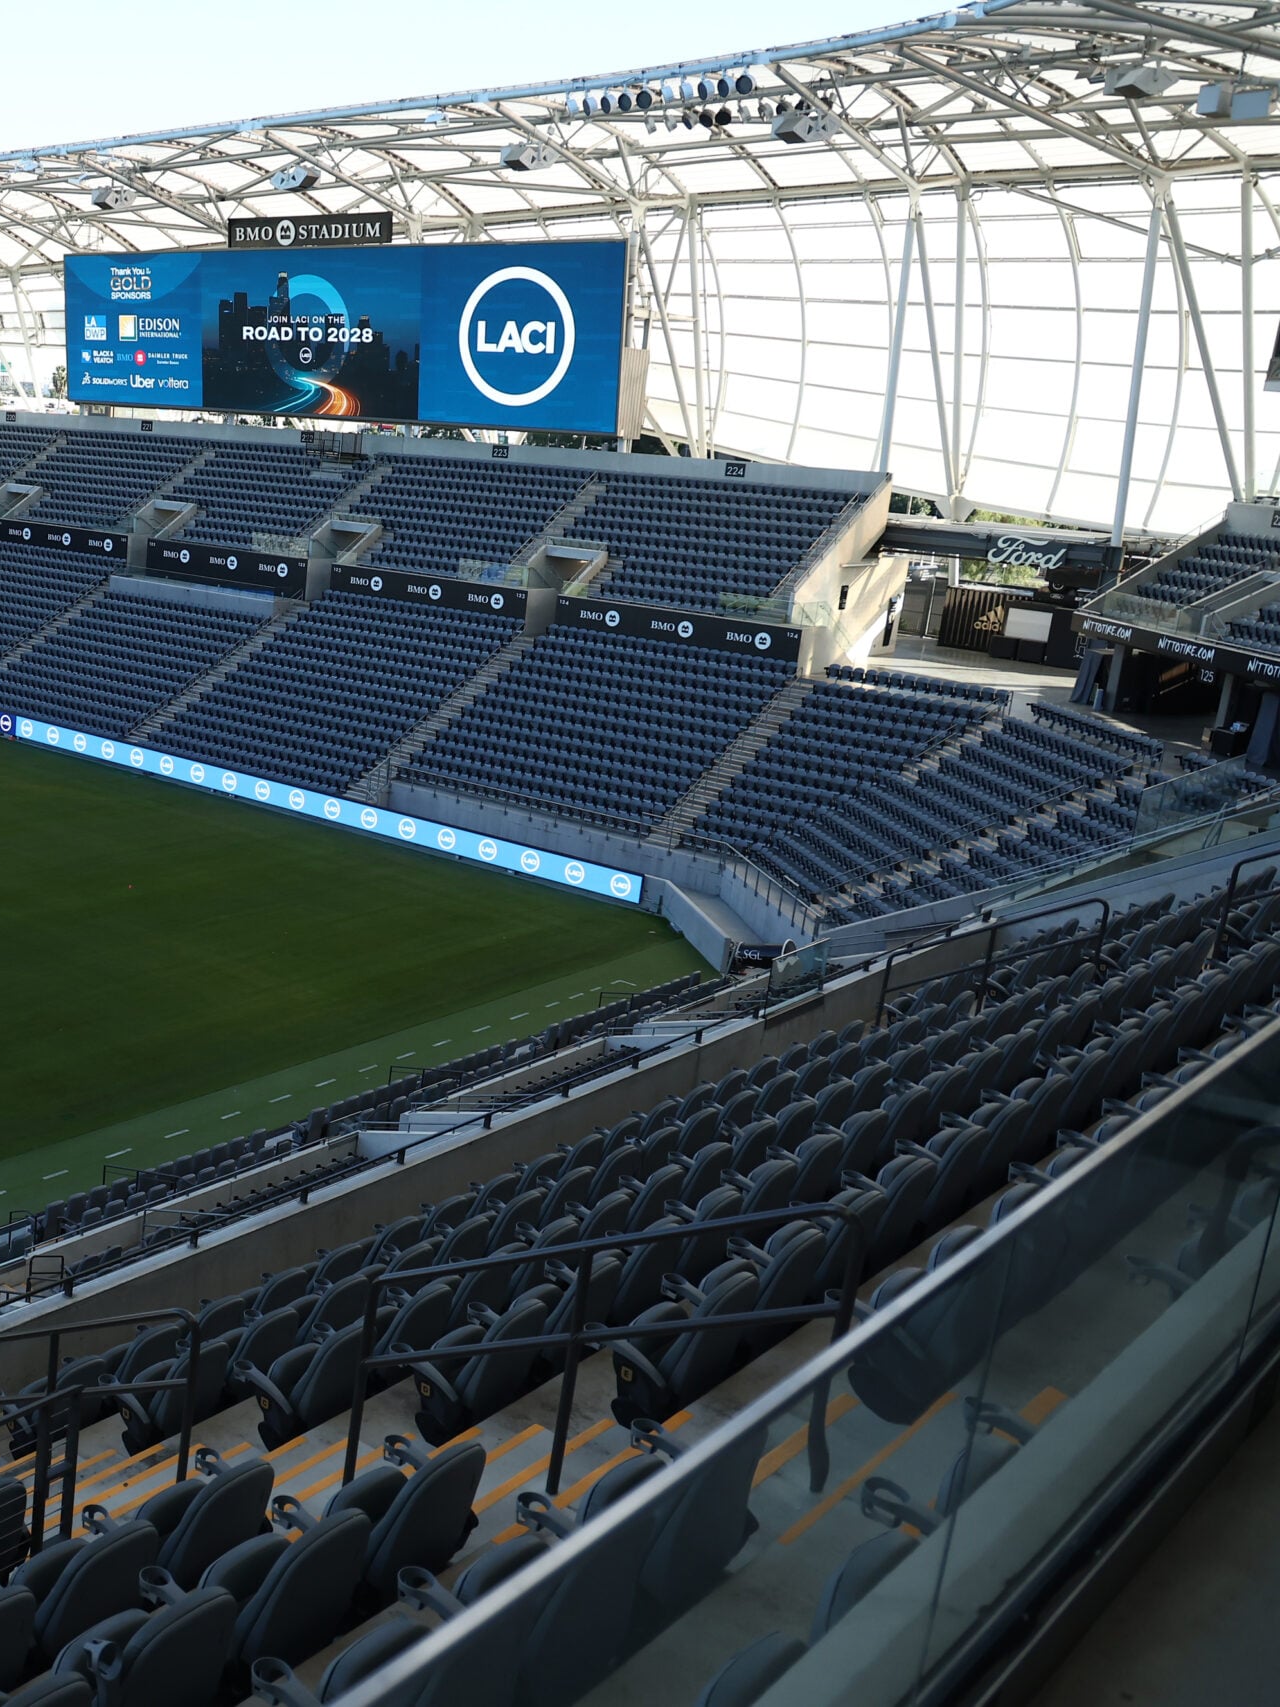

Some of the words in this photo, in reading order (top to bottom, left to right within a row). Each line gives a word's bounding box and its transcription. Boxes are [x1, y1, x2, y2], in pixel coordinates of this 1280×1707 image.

[235, 226, 272, 242] BMO
[298, 222, 381, 240] STADIUM
[110, 267, 131, 276] Thank
[110, 276, 152, 291] GOLD
[111, 292, 151, 300] SPONSORS
[85, 316, 97, 326] LA
[139, 318, 180, 331] EDISON
[268, 315, 288, 323] JOIN
[290, 316, 310, 324] LACI
[312, 316, 325, 324] ON
[328, 316, 345, 324] THE
[86, 329, 106, 337] DWP
[242, 326, 293, 340] ROAD
[297, 327, 323, 341] TO
[327, 328, 373, 343] 2028
[476, 319, 556, 355] LACI
[92, 378, 127, 386] SOLIDWORKS
[130, 374, 155, 388] Uber
[158, 377, 189, 389] voltera
[493, 448, 508, 457] 223
[726, 466, 744, 476] 224
[48, 534, 61, 542] BMO
[88, 540, 102, 548] BMO
[163, 550, 179, 559] BMO
[988, 535, 1067, 569] Ford
[209, 557, 225, 566] BMO
[258, 564, 276, 573] BMO
[350, 576, 369, 586] BMO
[407, 585, 427, 595] BMO
[468, 593, 489, 604] BMO
[580, 610, 603, 622] BMO
[651, 620, 675, 632] BMO
[974, 620, 1002, 632] adid
[1082, 618, 1132, 642] NITTOTIRE.COM
[726, 631, 752, 644] BMO
[1157, 637, 1216, 662] NITTOTIRE.COM
[1200, 669, 1214, 683] 125
[743, 950, 762, 960] SGL
